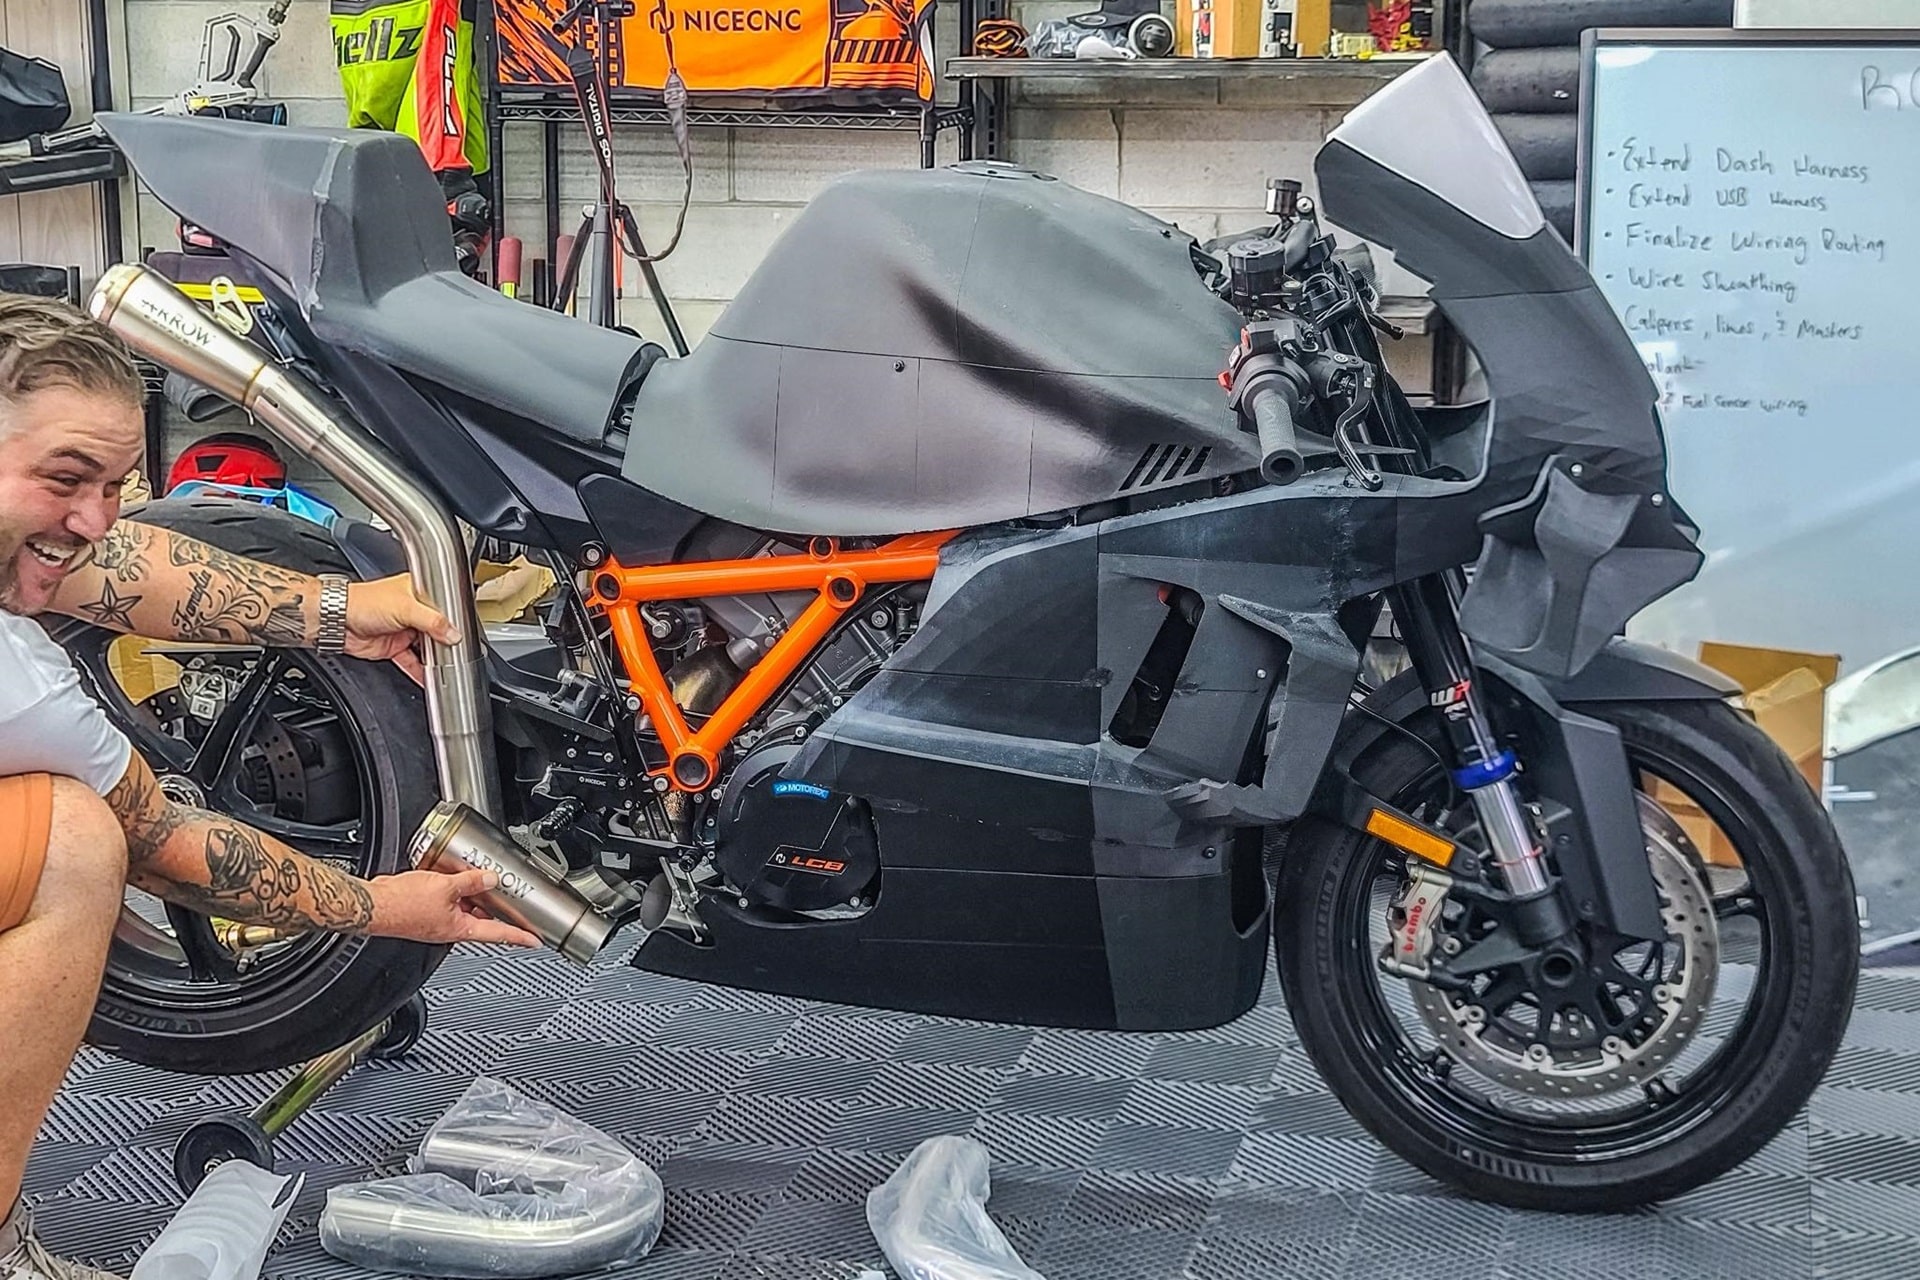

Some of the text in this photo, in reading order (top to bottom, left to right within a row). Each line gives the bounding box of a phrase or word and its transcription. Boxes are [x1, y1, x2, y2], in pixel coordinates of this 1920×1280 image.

[684, 9, 801, 32] NICECNC
[586, 83, 604, 136] DIGITAL
[1622, 136, 1869, 183] Extend Dash Harness
[1628, 183, 1690, 208] Extend
[1716, 187, 1748, 207] USB
[1626, 222, 1886, 265] Finalize Wiring Routing
[1628, 267, 1686, 289] Wire
[1797, 320, 1864, 340] Masters
[787, 783, 830, 799] MOTOREX
[1403, 896, 1427, 953] brembo
